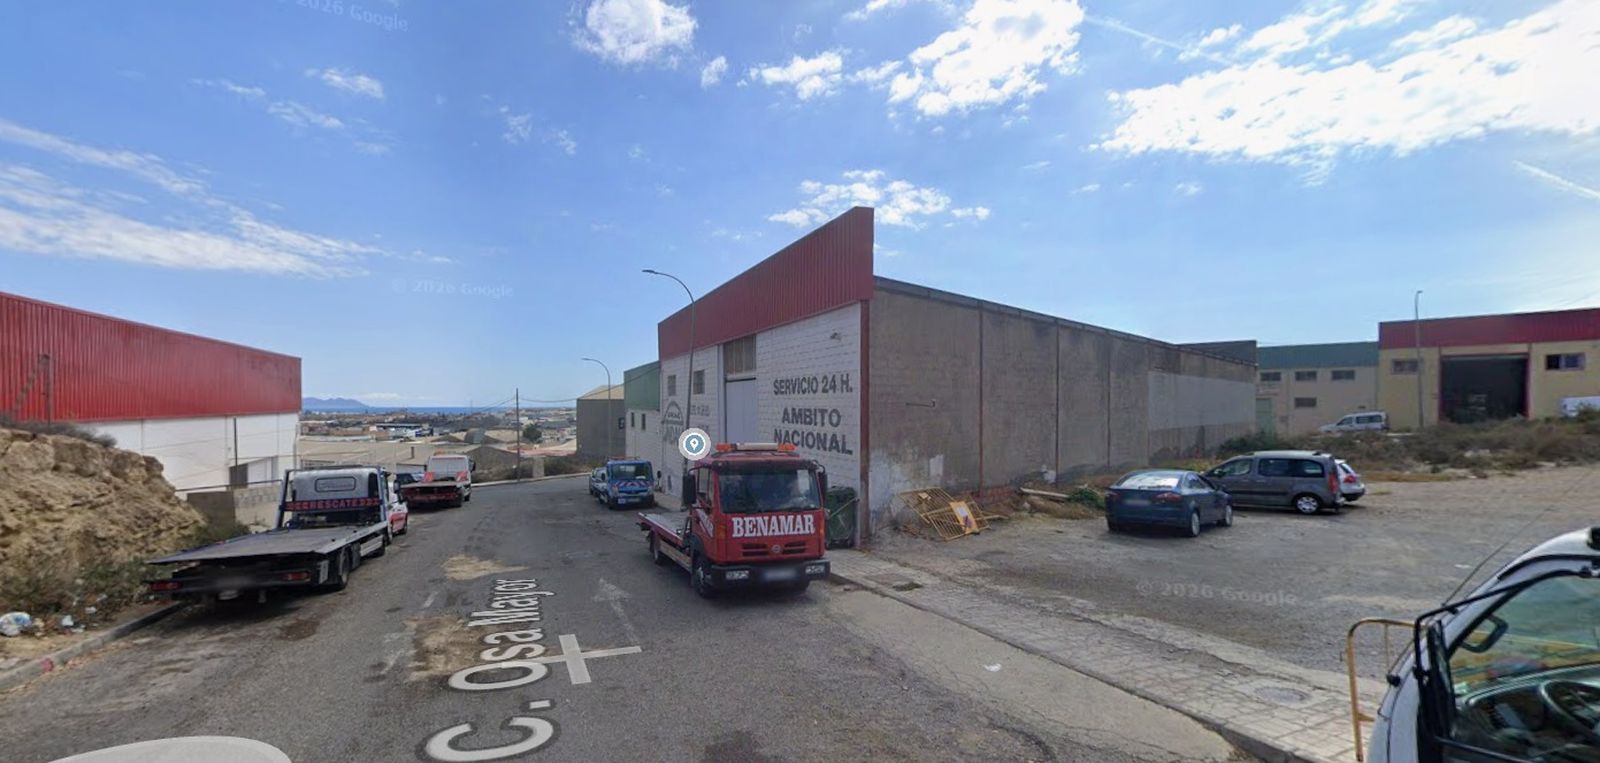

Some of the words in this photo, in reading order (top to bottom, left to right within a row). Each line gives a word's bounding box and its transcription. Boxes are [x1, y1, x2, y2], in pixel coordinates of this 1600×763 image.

[773, 376, 819, 396] SERVICIO
[821, 375, 837, 394] 24
[840, 373, 853, 393] H.
[781, 406, 842, 428] AMBITO
[773, 428, 854, 455] NACIONAL
[731, 514, 816, 538] BENAMAR
